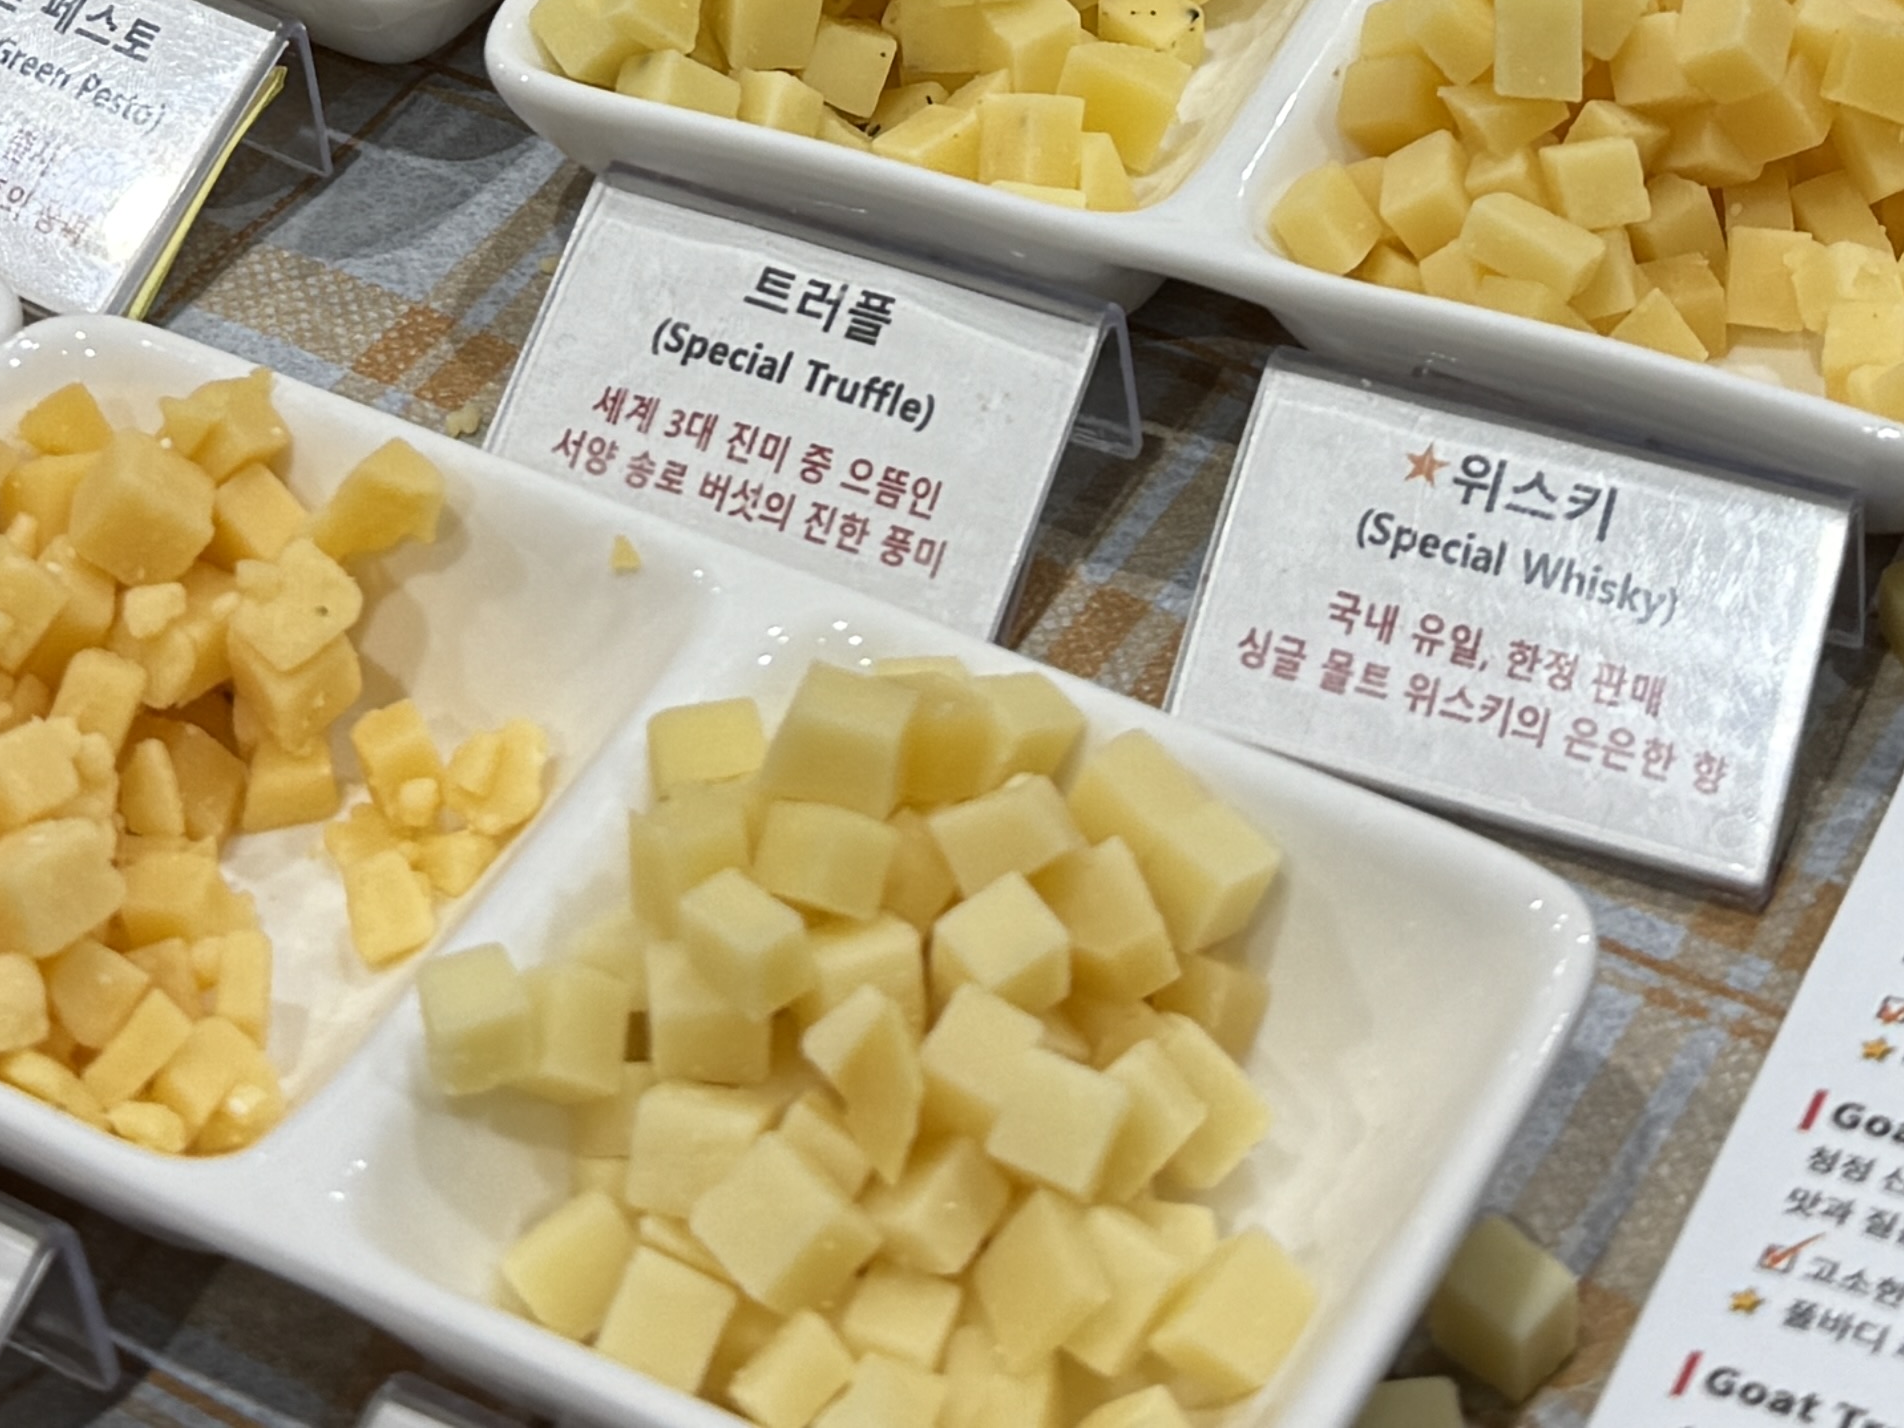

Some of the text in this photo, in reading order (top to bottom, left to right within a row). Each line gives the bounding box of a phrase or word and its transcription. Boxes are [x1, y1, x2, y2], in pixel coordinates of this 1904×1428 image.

[744, 265, 896, 346] 트러플
[650, 316, 935, 433] (Special Truffle)
[590, 384, 943, 518] 세계 3대 진미 중 으뜸인
[1452, 453, 1618, 542] 위스키
[1355, 506, 1679, 627] (Special Whisky)
[1702, 1365, 1821, 1424] Goat
